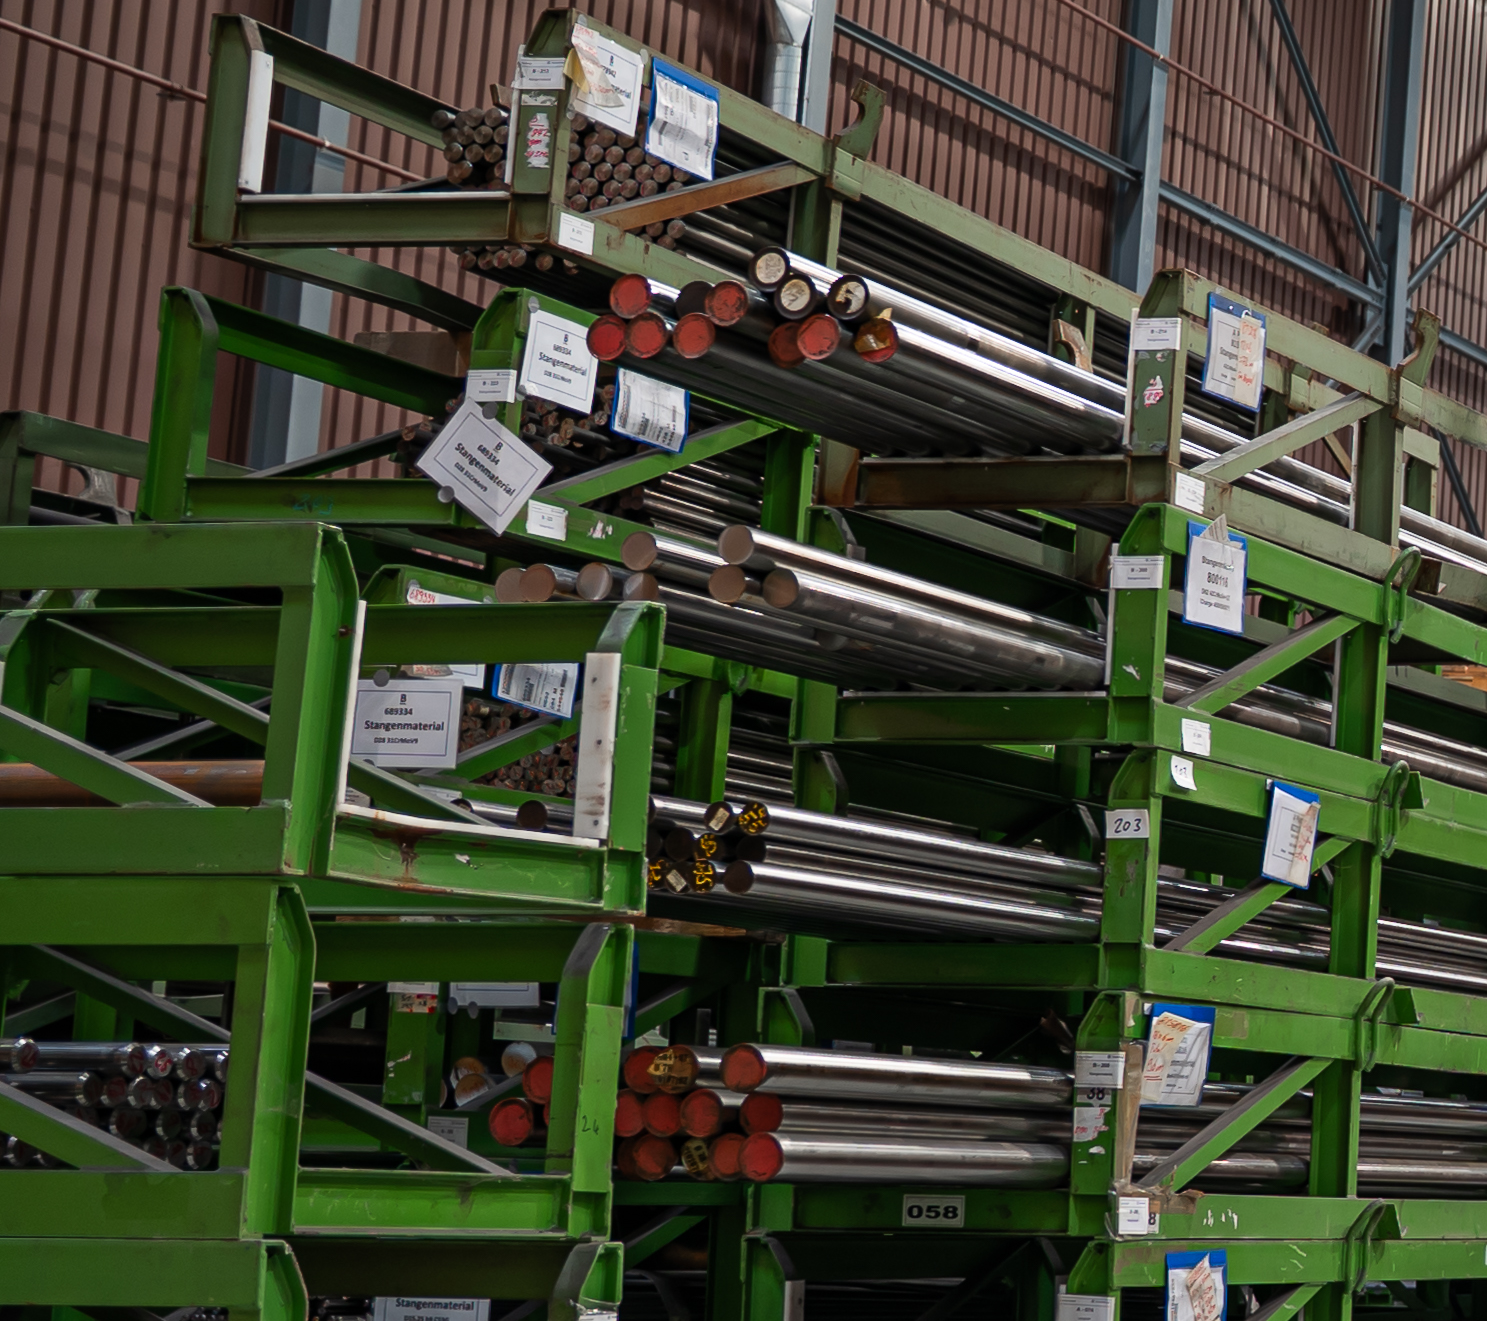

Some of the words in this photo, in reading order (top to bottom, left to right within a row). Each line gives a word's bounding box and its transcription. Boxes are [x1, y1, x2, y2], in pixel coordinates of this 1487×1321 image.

[495, 441, 504, 452] B
[476, 443, 501, 466] 689334
[454, 441, 517, 498] Stangenmaterial
[400, 693, 407, 703] B
[384, 707, 413, 716] 689334
[364, 720, 445, 732] Stangenmaterial
[1113, 817, 1143, 834] 203
[906, 1204, 960, 1220] 058
[395, 1297, 475, 1311] Stangenmaterial
